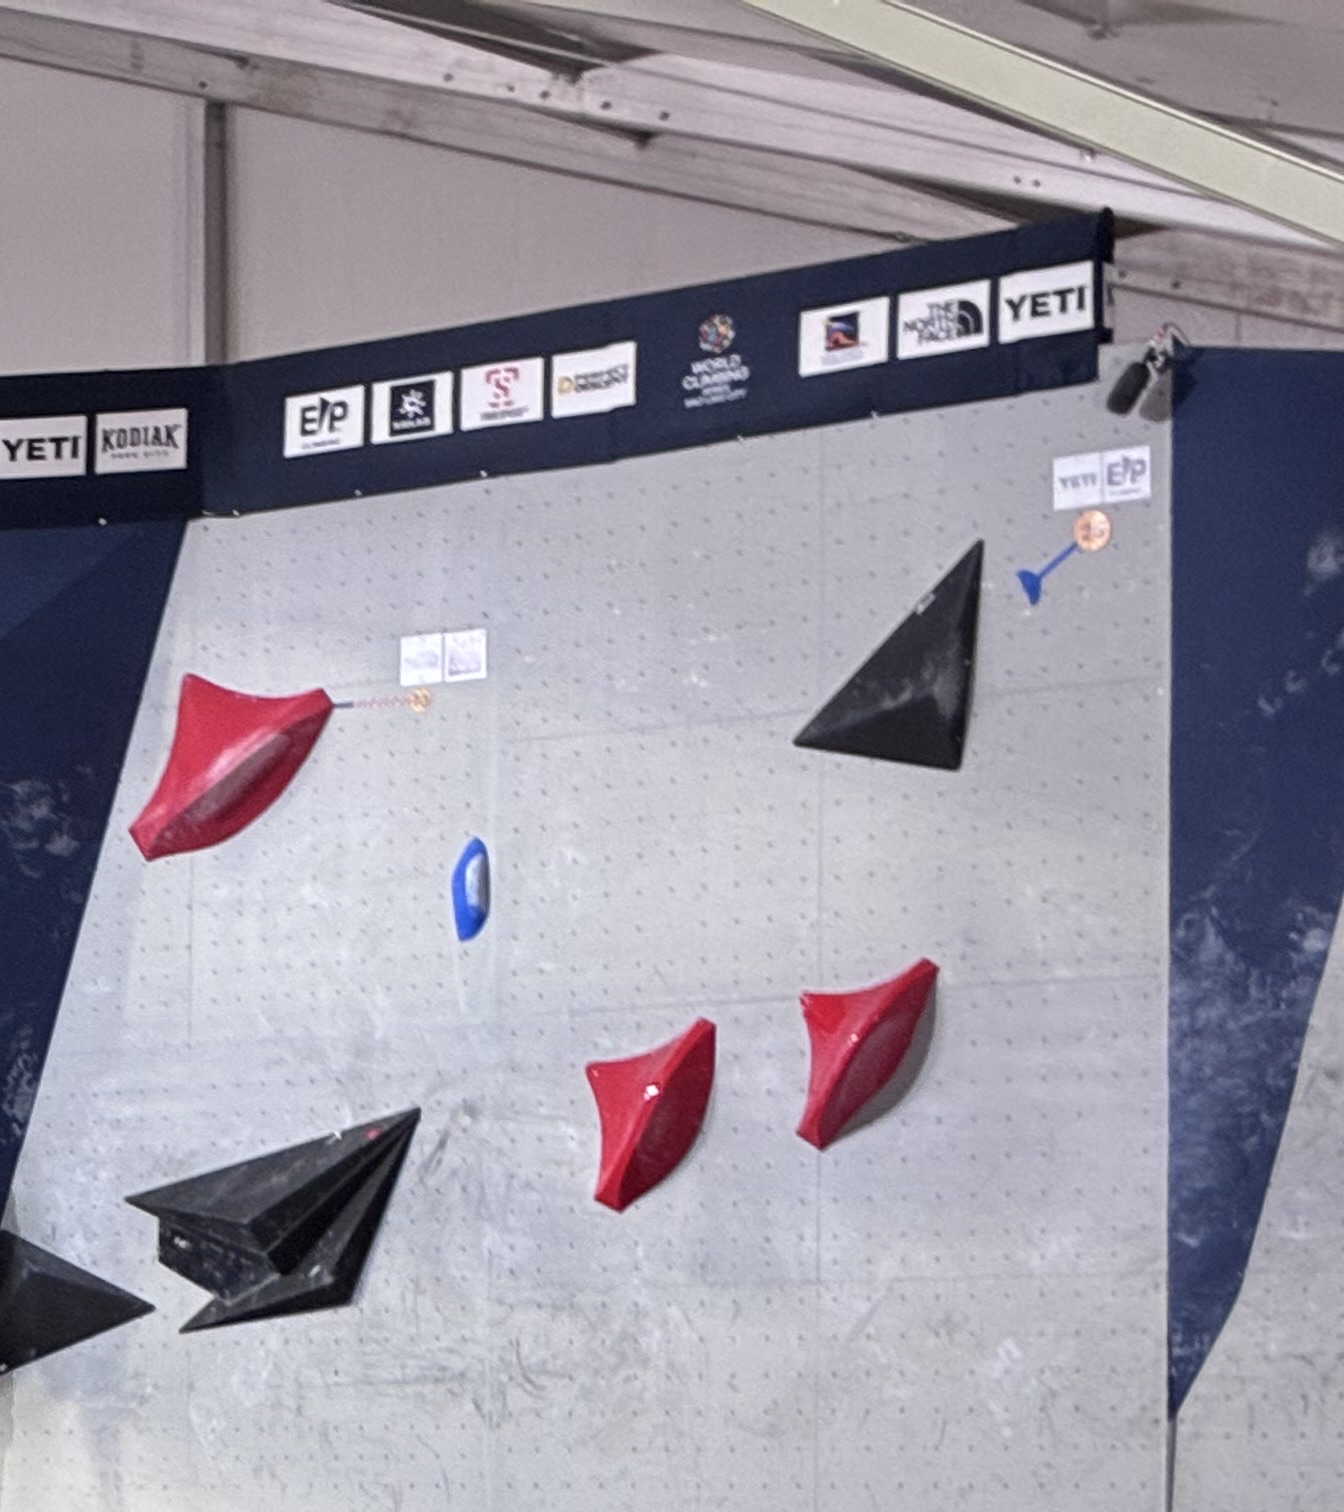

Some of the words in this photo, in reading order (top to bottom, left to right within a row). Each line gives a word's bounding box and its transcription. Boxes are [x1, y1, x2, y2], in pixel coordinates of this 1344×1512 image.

[1005, 285, 1086, 322] YETI
[691, 354, 742, 374] WORLD
[1, 436, 82, 462] YETI
[101, 424, 182, 453] KODIAK
